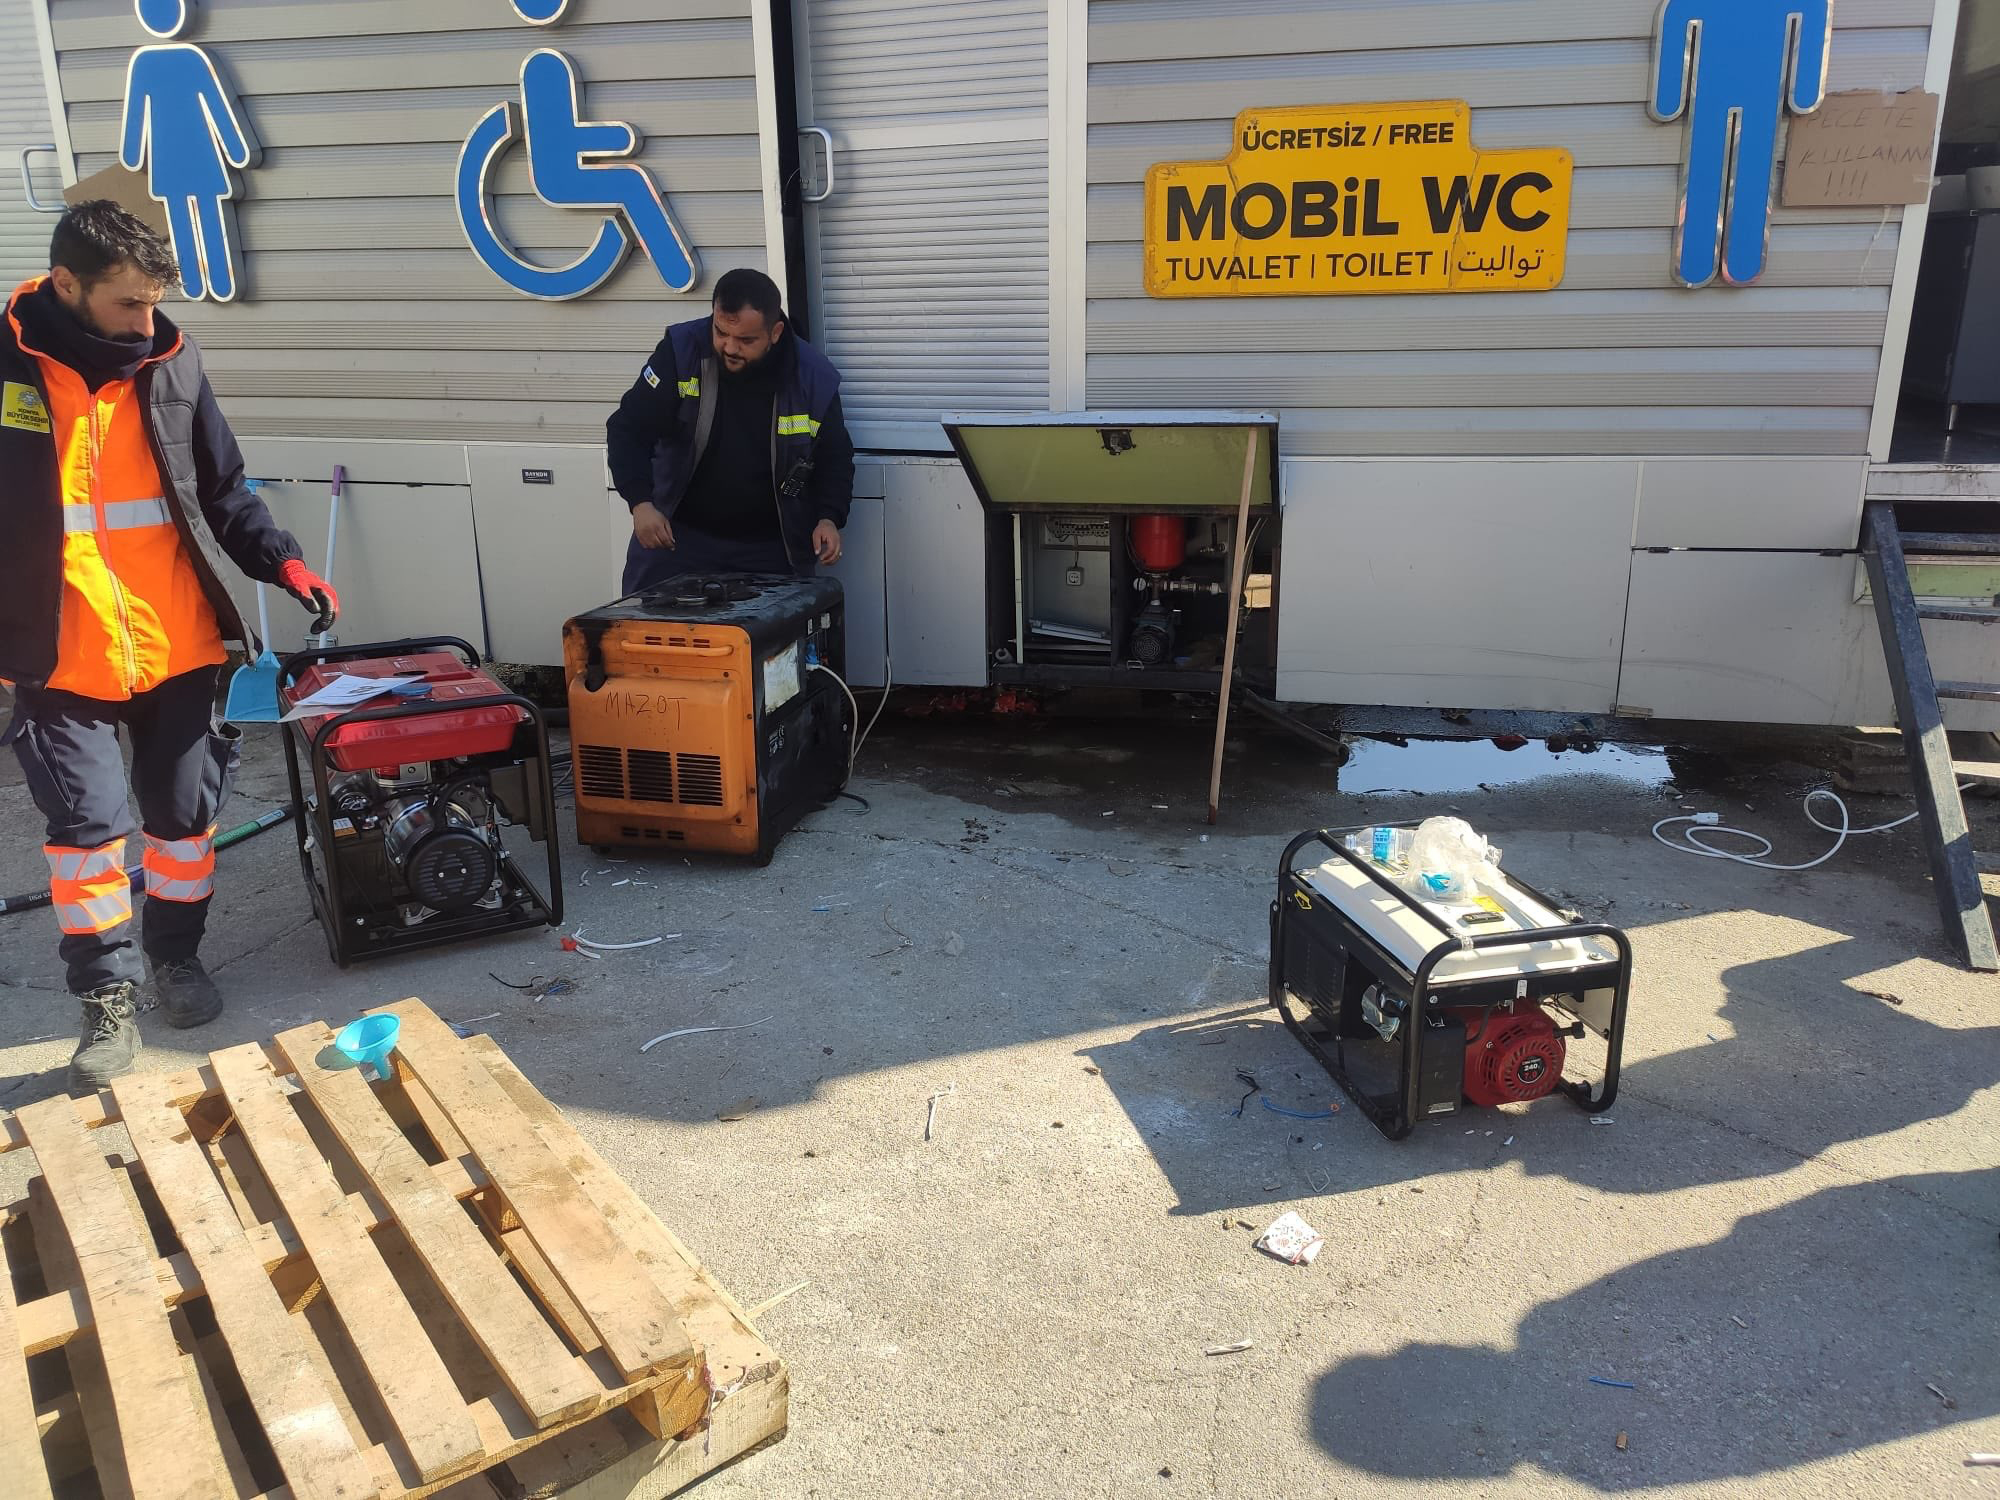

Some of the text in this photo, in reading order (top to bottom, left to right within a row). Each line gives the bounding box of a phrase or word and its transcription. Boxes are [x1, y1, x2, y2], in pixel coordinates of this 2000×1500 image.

[1242, 121, 1367, 152] ÜCRETSİZ
[1389, 122, 1454, 145] FREE
[1421, 171, 1553, 234] WC
[1165, 254, 1301, 281] TUVALET
[1325, 251, 1434, 278] TOILET
[1457, 244, 1545, 279] تواليت
[606, 691, 689, 731] MAZOT
